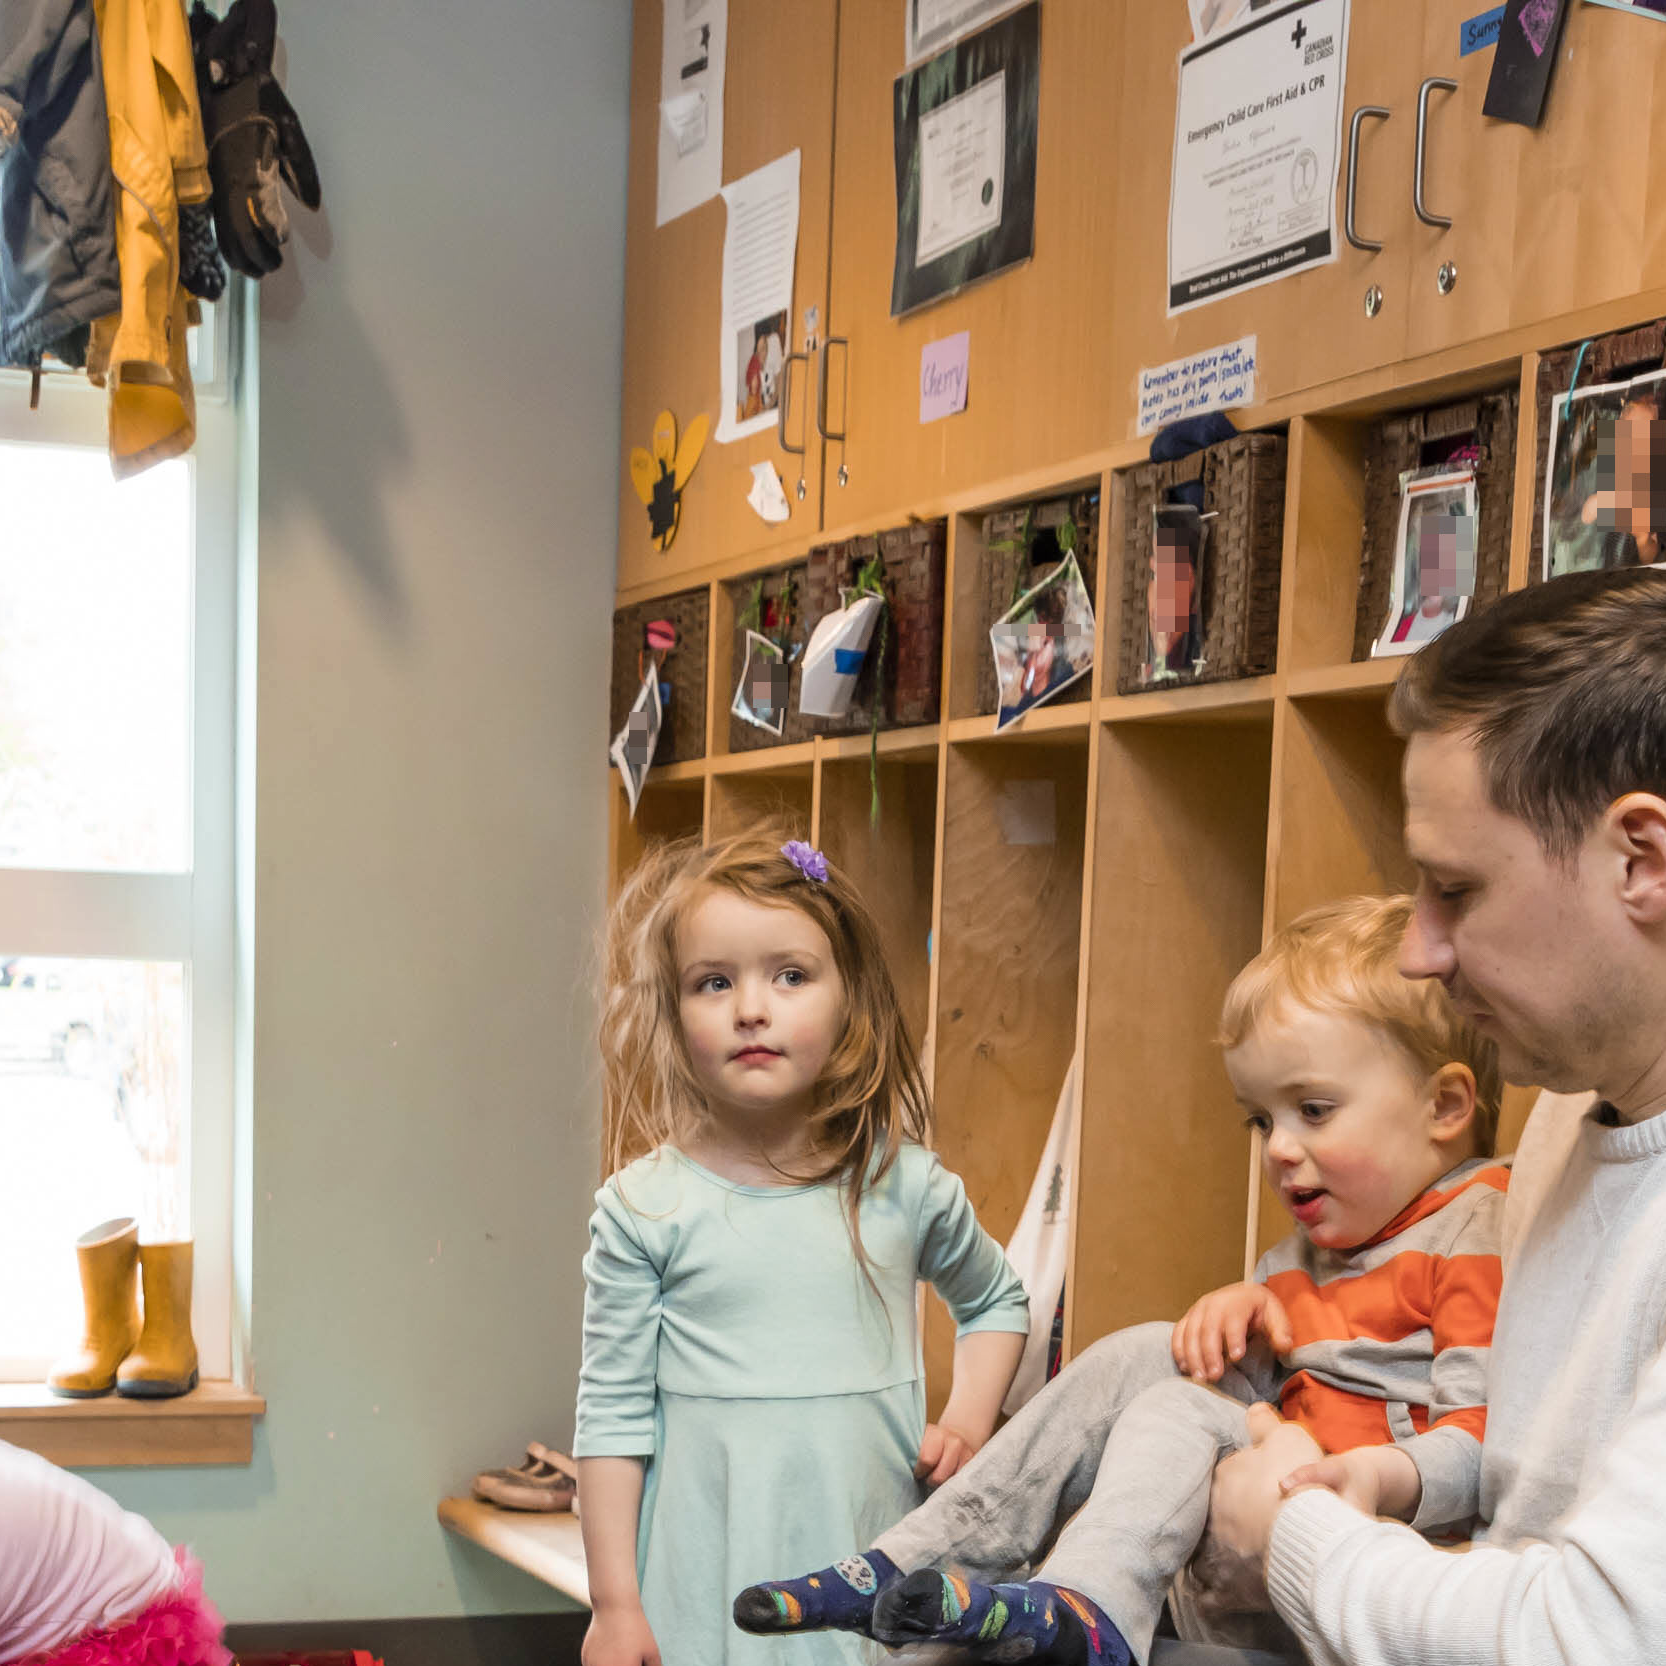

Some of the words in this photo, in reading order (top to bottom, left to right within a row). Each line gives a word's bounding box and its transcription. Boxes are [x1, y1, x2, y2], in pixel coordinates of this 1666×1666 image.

[1303, 52, 1315, 66] RED
[1315, 46, 1334, 61] CROSS
[1304, 36, 1333, 55] CANADIAN
[1188, 119, 1225, 144] Emergency
[1227, 104, 1246, 126] Child
[1247, 101, 1265, 118] Care
[1266, 92, 1283, 112] First
[1284, 87, 1298, 101] Aid
[1300, 82, 1306, 96] &
[1308, 74, 1325, 92] CPR
[1143, 367, 1179, 390] Remember
[1181, 361, 1190, 376] to
[1220, 344, 1242, 362] that
